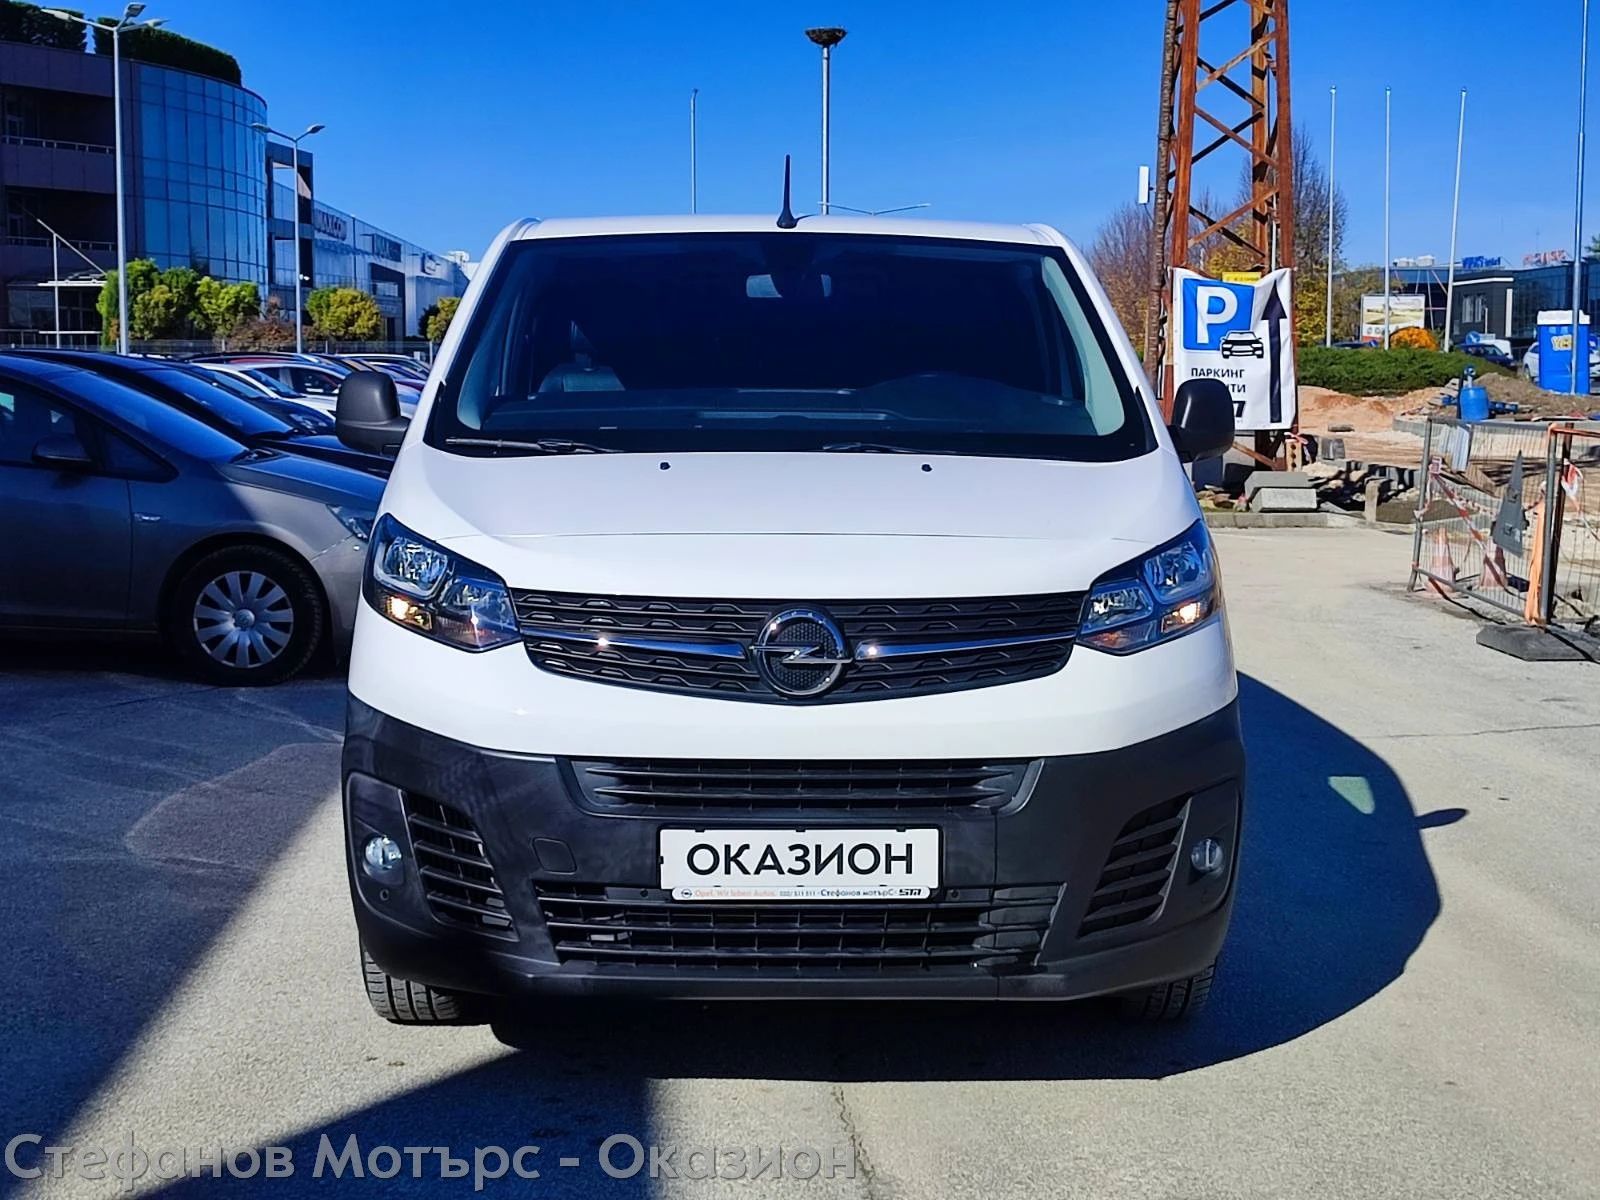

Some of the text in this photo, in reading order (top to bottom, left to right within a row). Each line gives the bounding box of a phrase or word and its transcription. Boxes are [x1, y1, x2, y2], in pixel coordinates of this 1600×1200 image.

[1196, 286, 1238, 344] P
[1190, 367, 1245, 378] ПАРКИНГ
[686, 842, 913, 876] ОКАЗИОН
